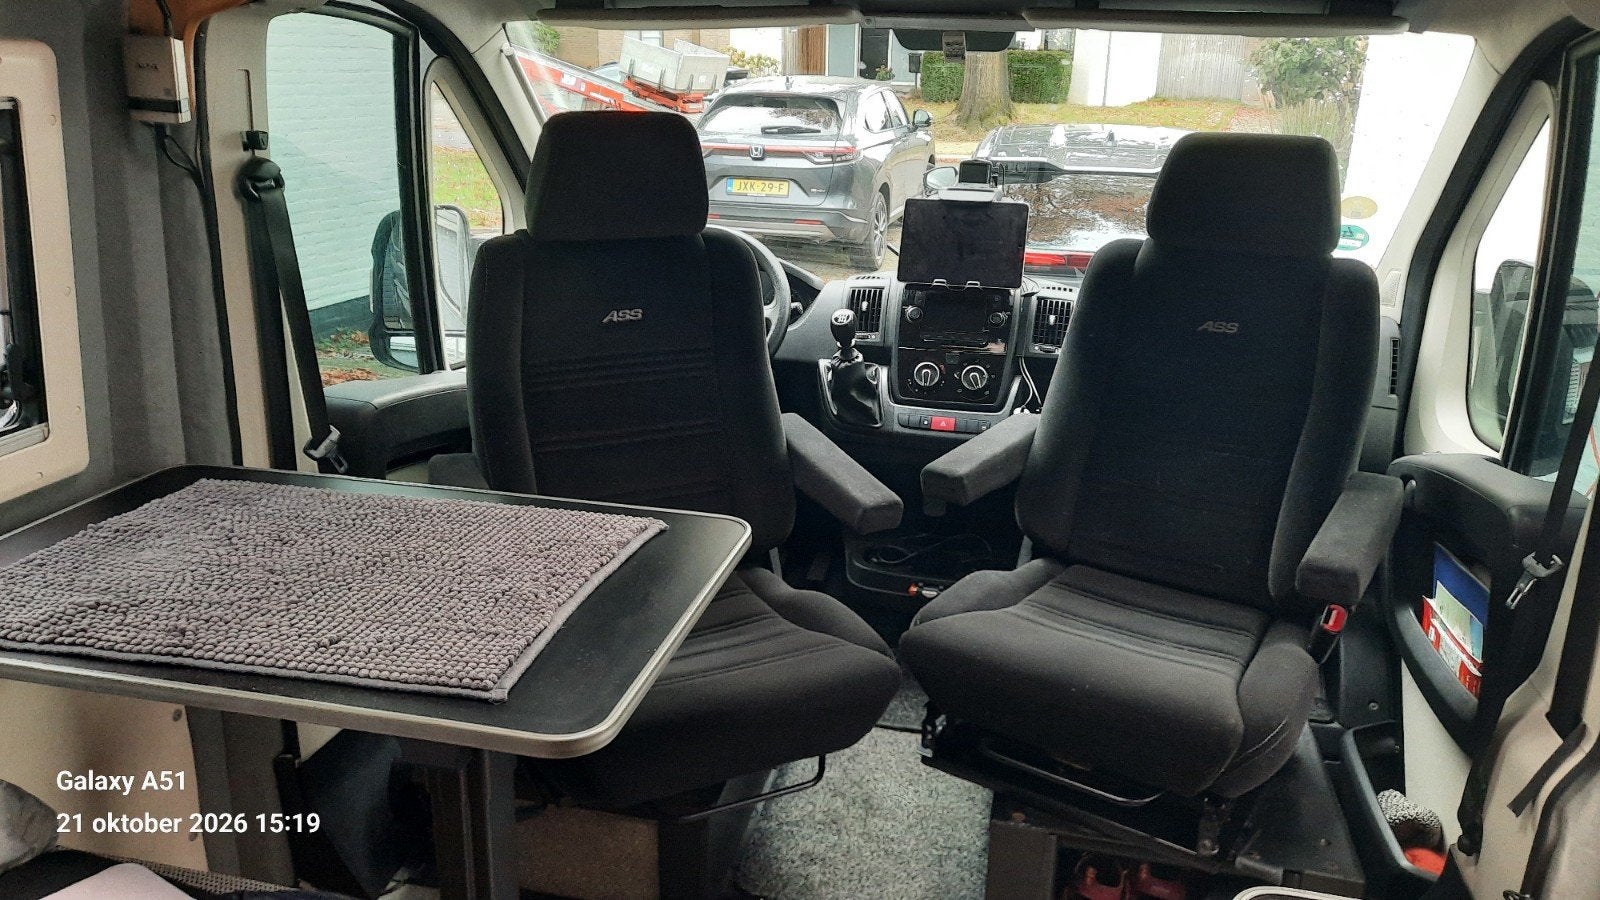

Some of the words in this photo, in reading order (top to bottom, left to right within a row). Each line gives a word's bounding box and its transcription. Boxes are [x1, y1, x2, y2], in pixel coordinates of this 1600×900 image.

[736, 181, 785, 193] JXK-29-F
[601, 308, 643, 323] ASS
[1196, 321, 1239, 333] ASS
